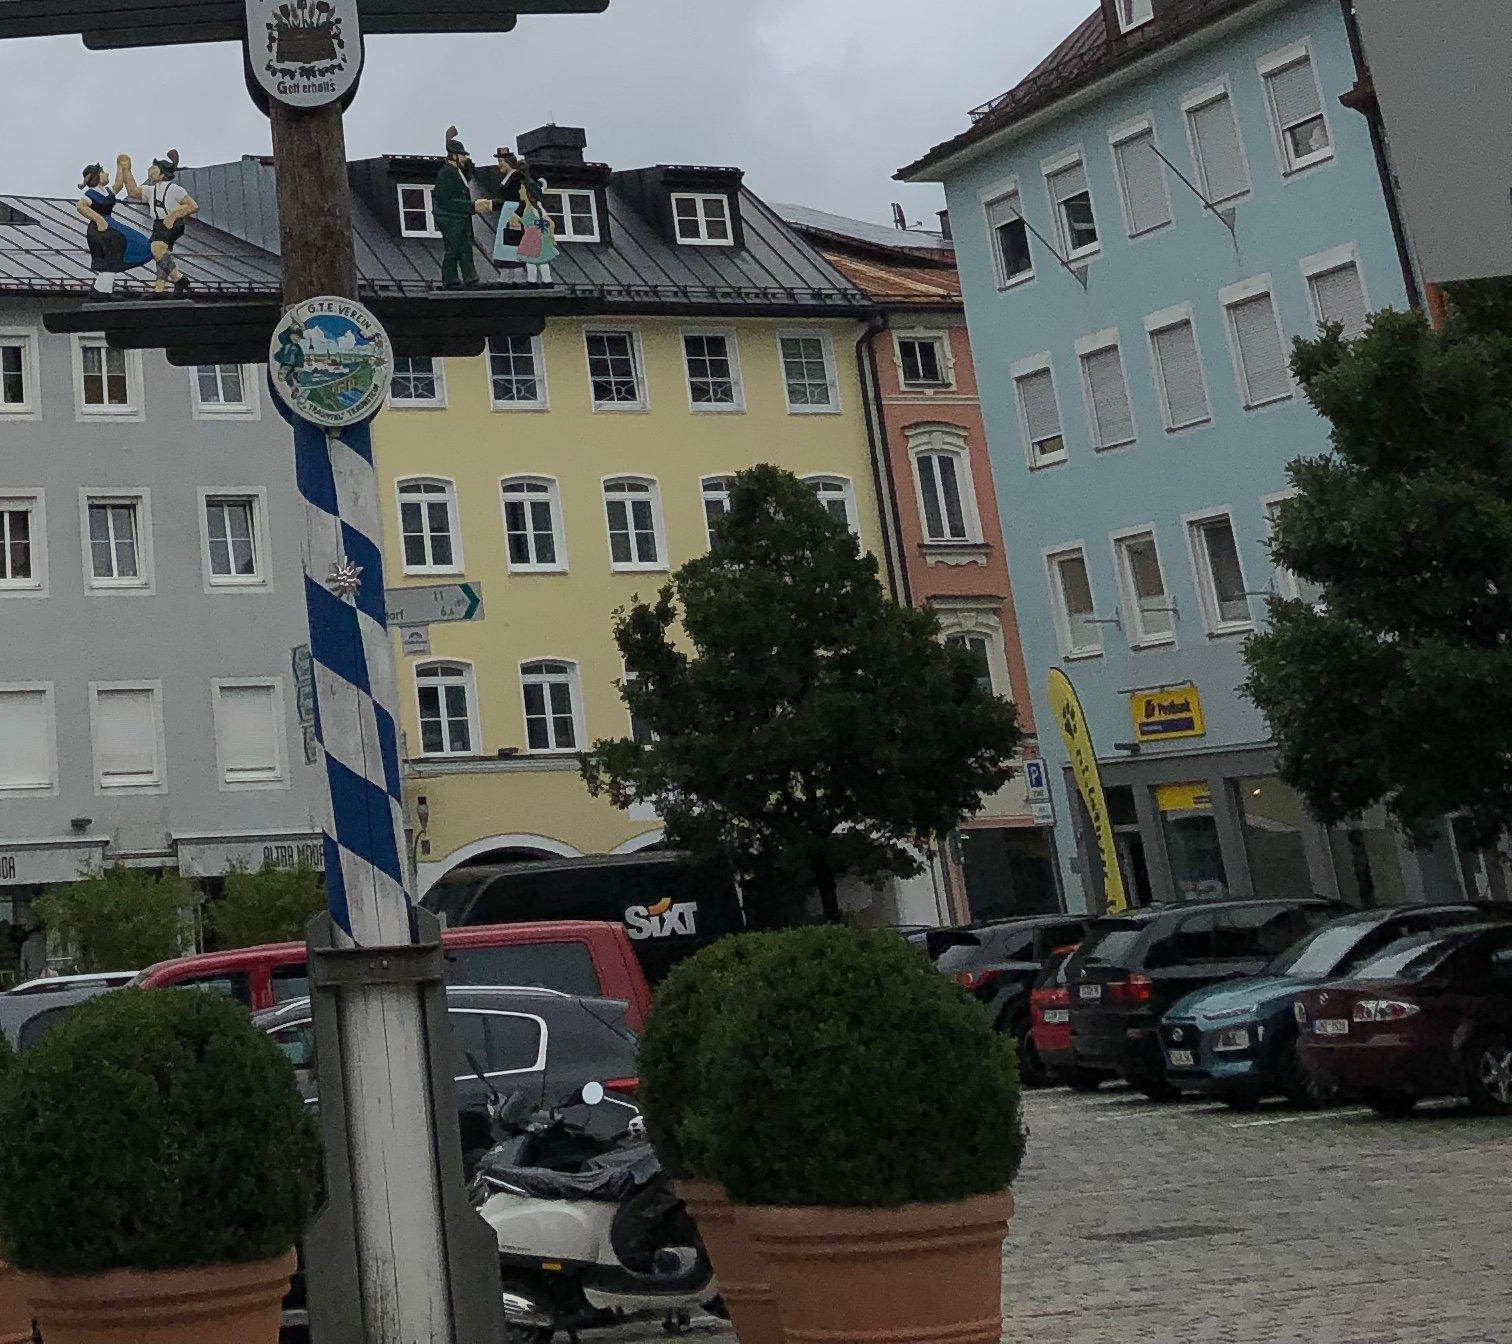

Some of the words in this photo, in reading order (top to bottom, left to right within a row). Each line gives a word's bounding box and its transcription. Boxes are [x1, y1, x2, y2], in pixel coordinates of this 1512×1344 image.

[276, 81, 300, 95] Gott
[338, 304, 372, 330] VEREIN
[263, 845, 295, 868] ALTRA
